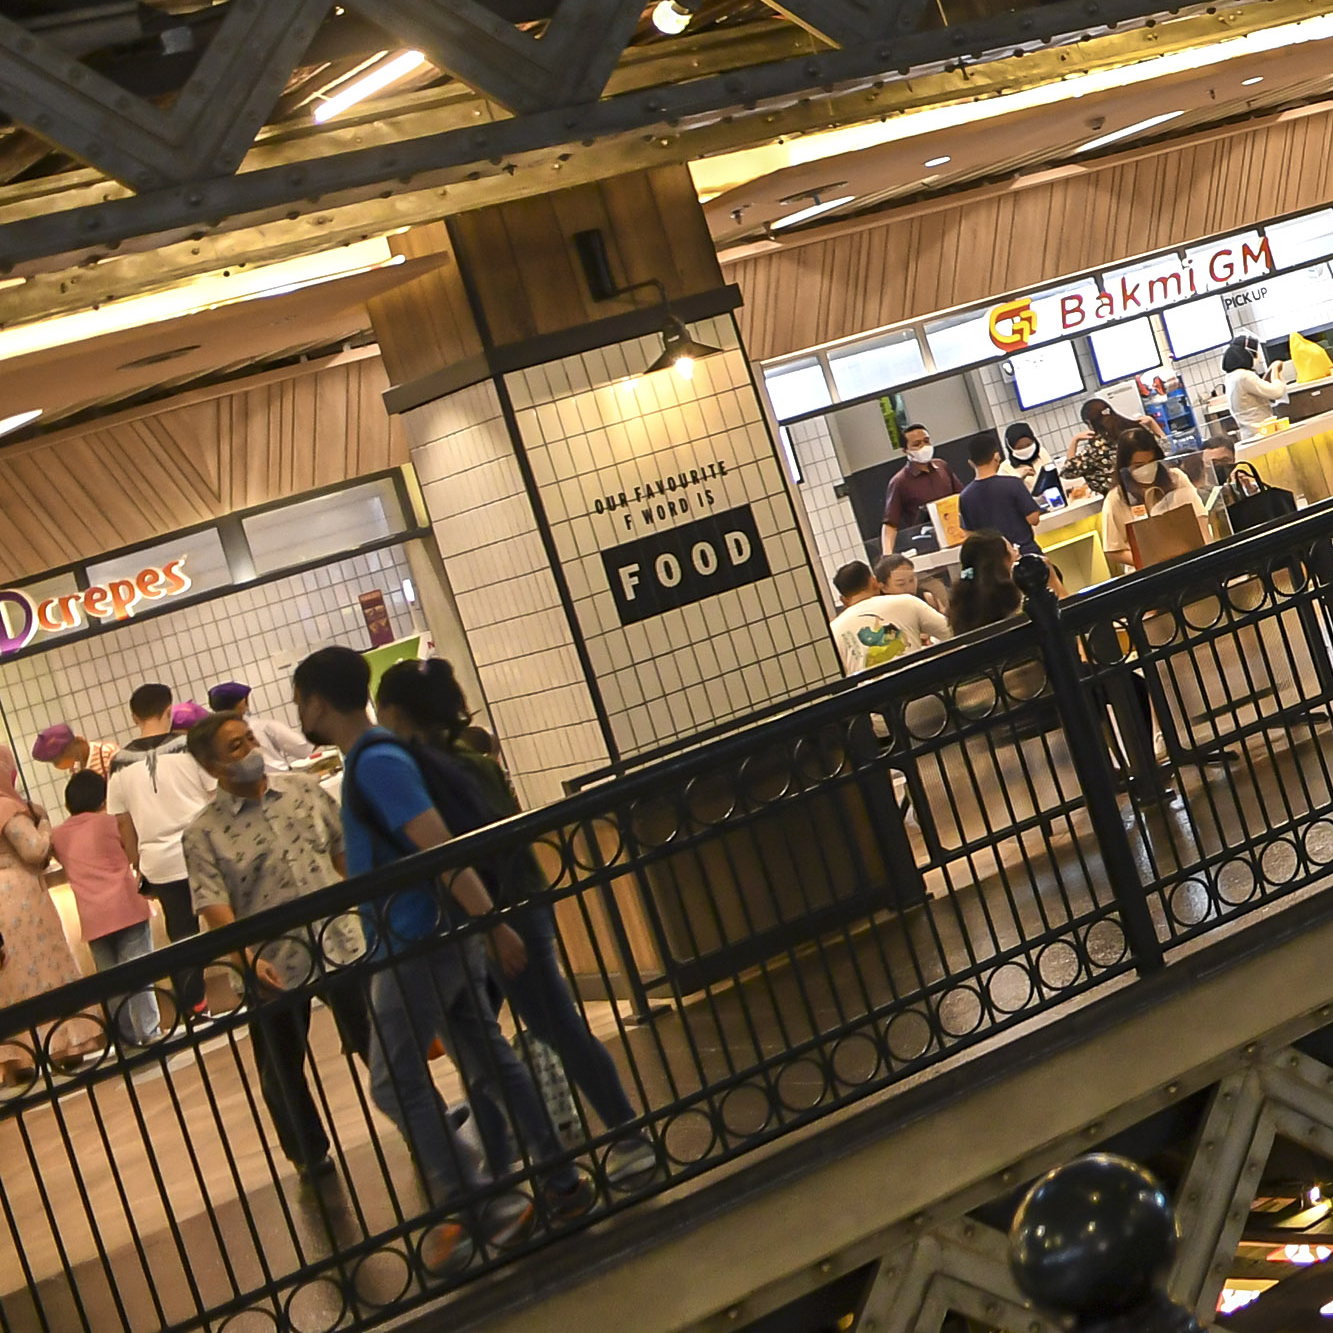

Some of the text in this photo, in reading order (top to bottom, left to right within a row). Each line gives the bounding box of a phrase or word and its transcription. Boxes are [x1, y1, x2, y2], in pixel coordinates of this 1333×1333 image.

[1060, 257, 1198, 330] Bakmi
[1208, 236, 1274, 283] GM
[1224, 287, 1268, 311] PICK UP
[594, 460, 728, 515] OUR FAVOURITE
[624, 489, 715, 531] F WORD IS
[617, 530, 752, 601] FOOD
